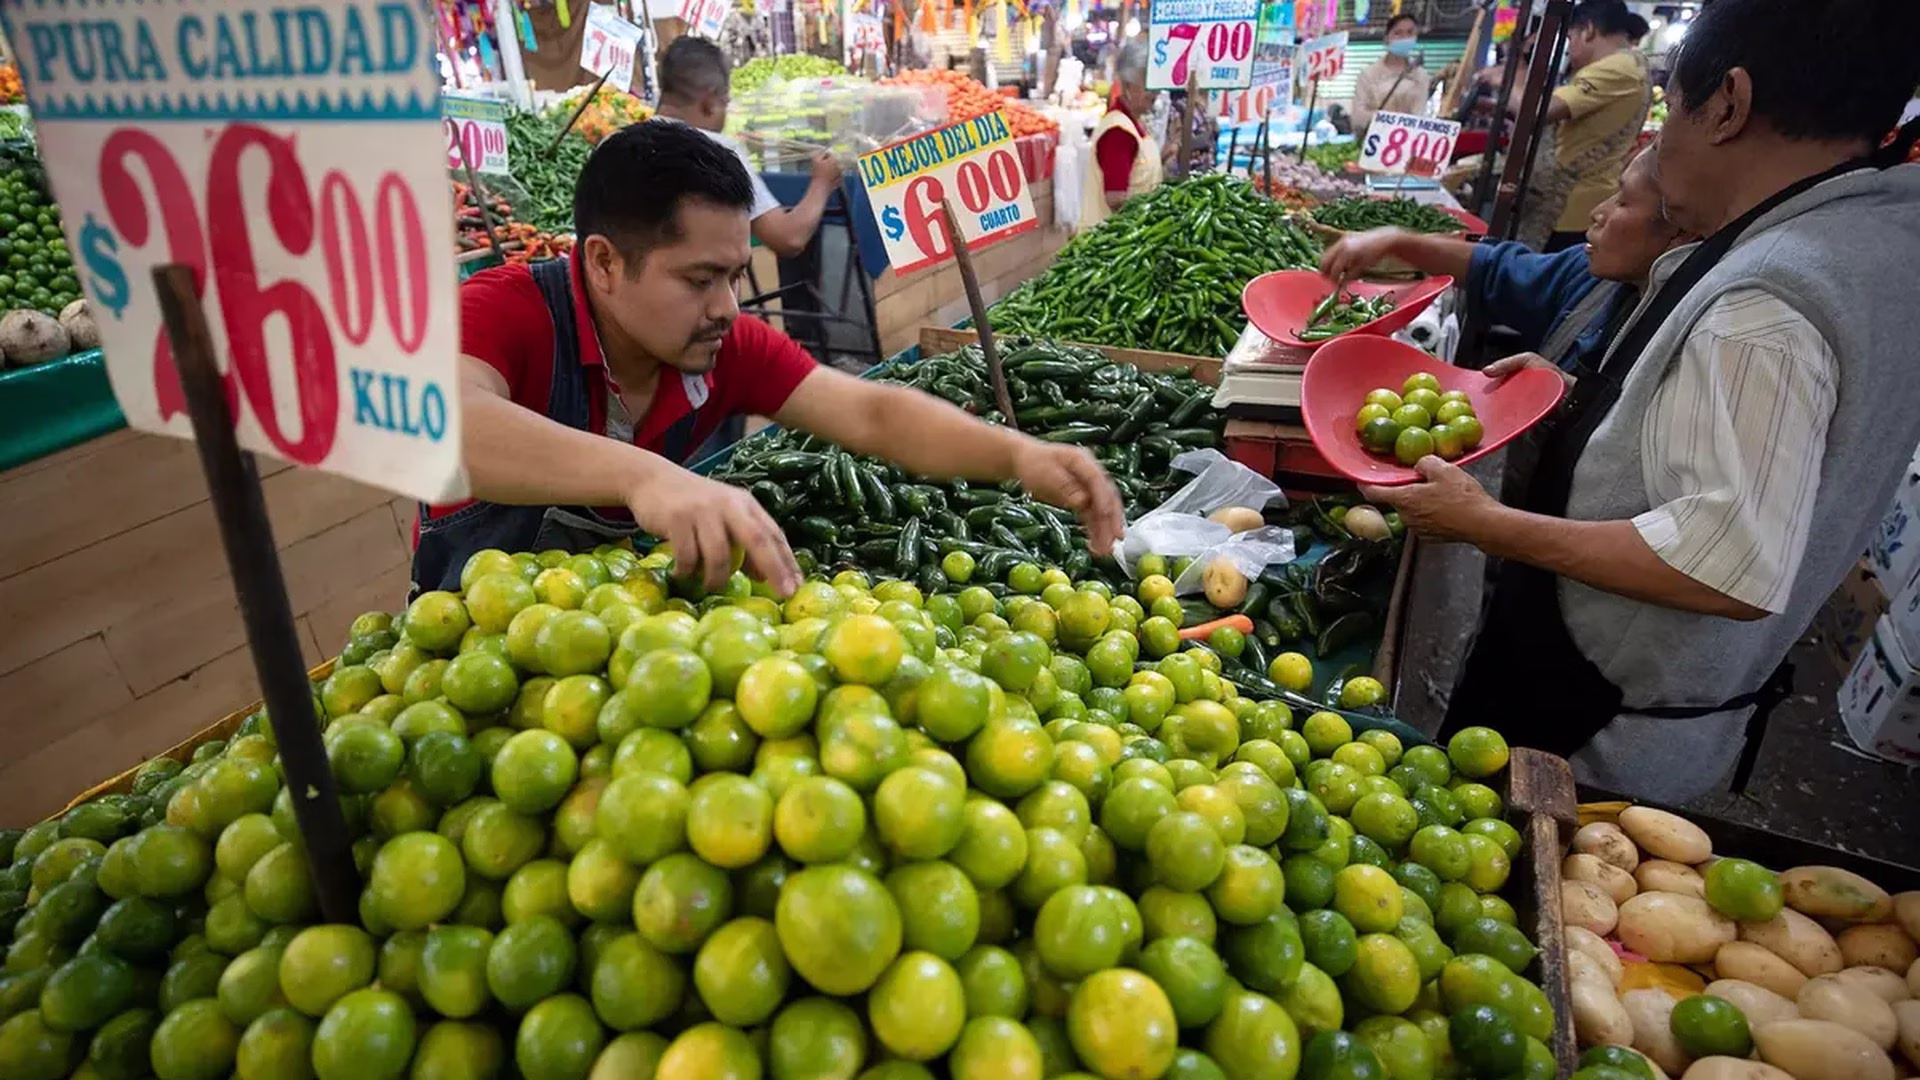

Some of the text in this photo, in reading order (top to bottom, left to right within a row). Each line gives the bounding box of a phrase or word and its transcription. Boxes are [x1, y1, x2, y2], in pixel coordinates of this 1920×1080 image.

[28, 4, 420, 83] PURA CALIDAD
[860, 112, 1009, 188] LO MEJOR DEL DIA
[1375, 112, 1396, 125] MAS
[1398, 115, 1418, 129] POR
[1418, 119, 1451, 134] MENOS
[979, 203, 1021, 231] CUARTO
[349, 366, 448, 442] KILO
